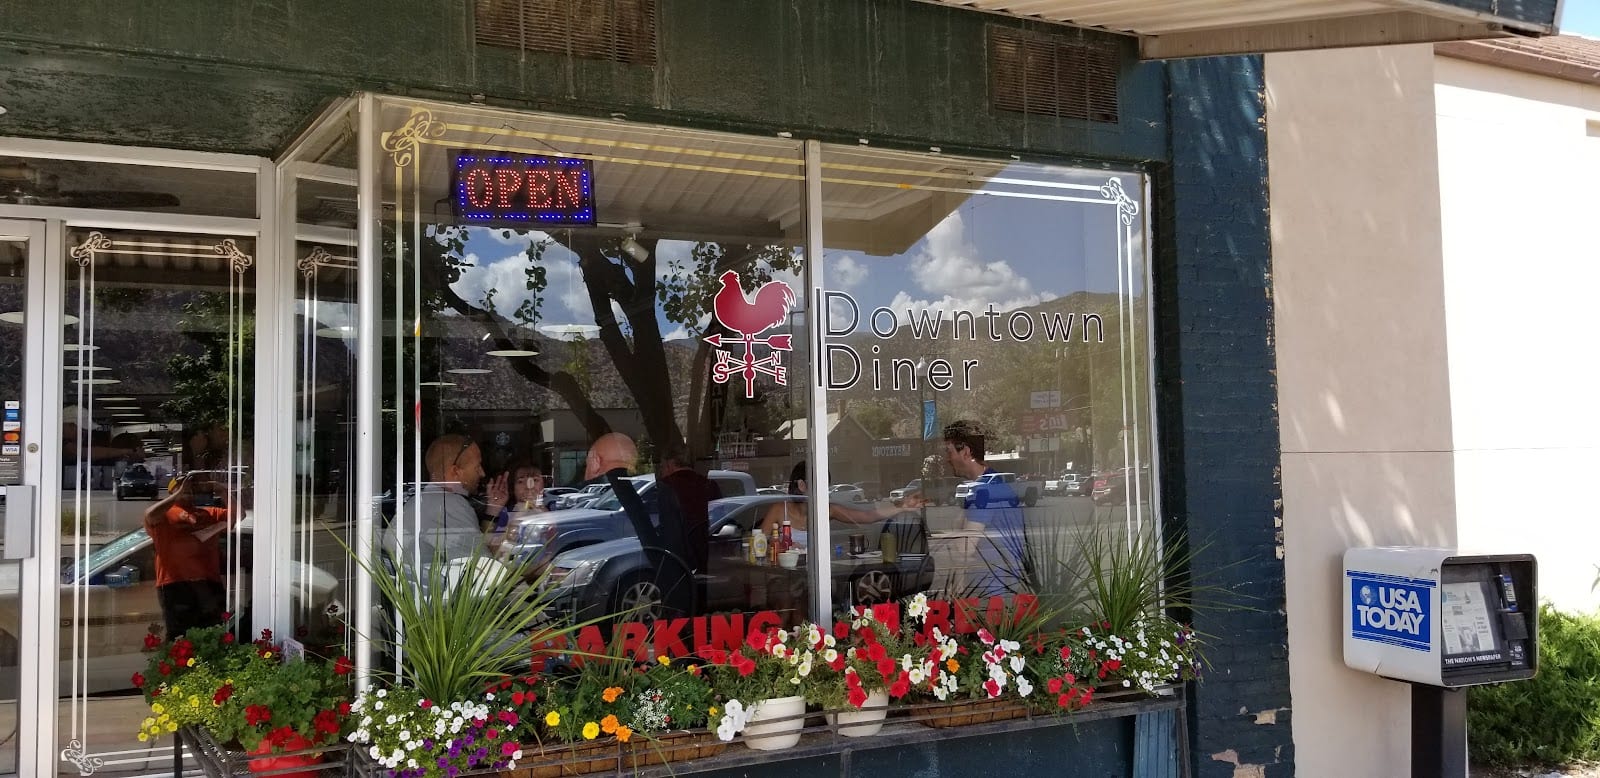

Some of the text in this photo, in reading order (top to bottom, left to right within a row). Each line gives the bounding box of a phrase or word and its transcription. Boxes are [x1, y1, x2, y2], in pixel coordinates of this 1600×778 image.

[466, 168, 581, 208] OPEN
[824, 290, 1105, 342] Downtown
[713, 362, 729, 383] S
[771, 351, 781, 366] N
[826, 344, 979, 391] Diner
[775, 366, 787, 386] E
[1379, 586, 1423, 614] USA
[1356, 605, 1425, 635] TODAY
[1476, 653, 1501, 662] NEWSPAPER
